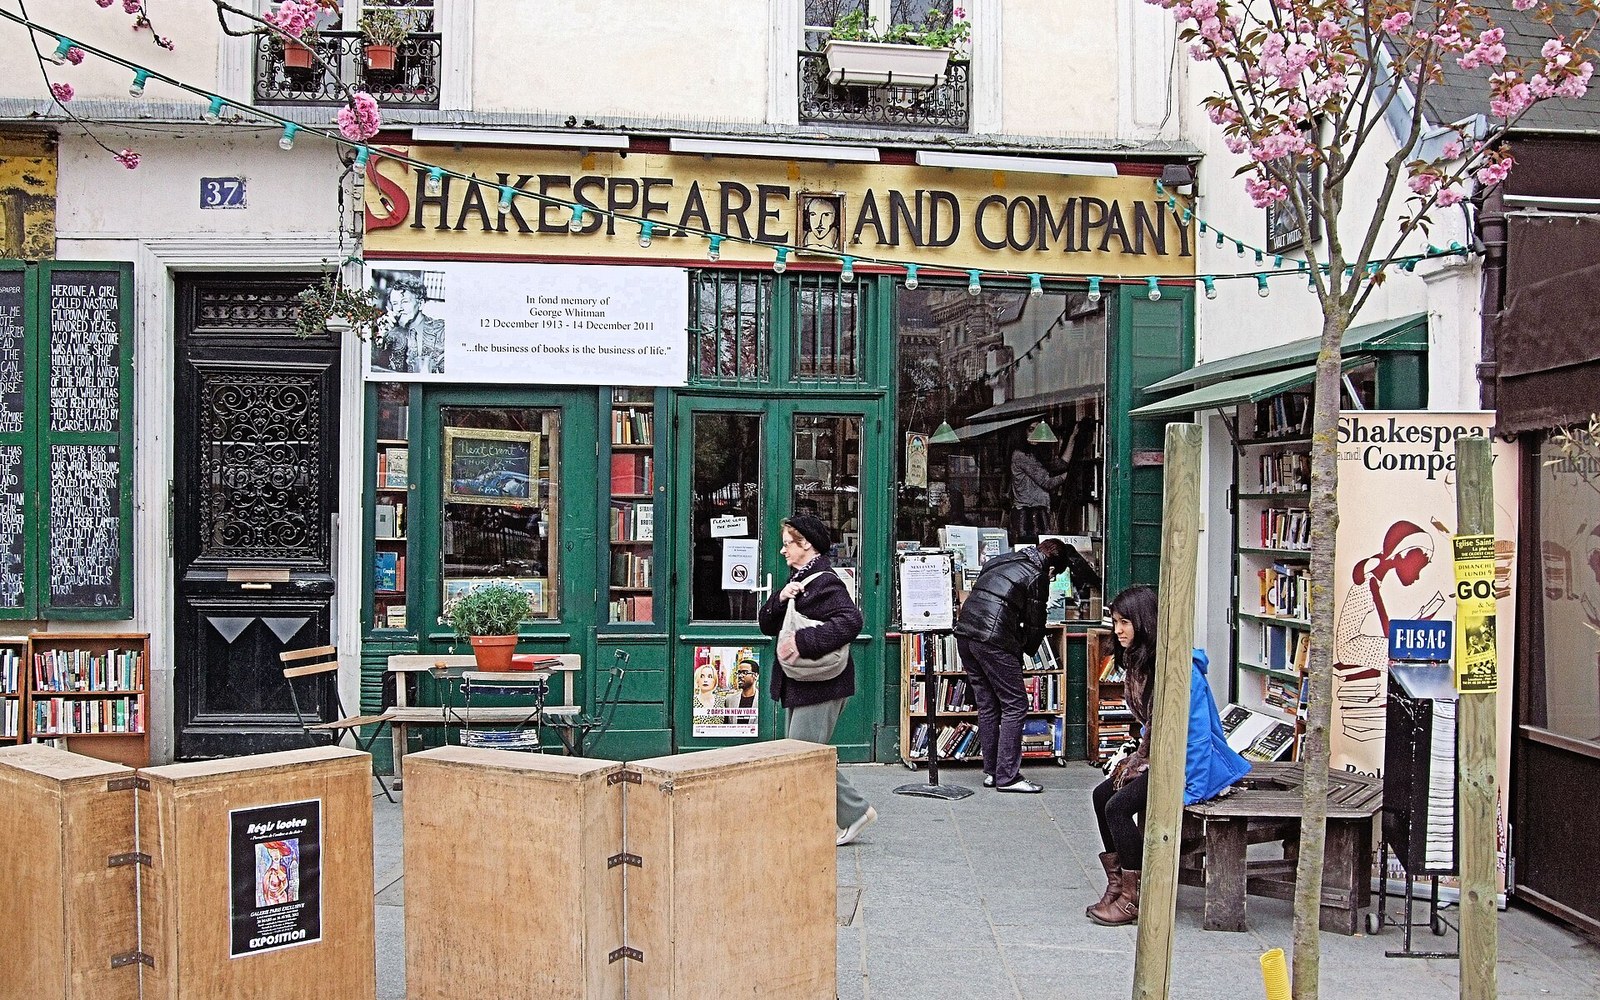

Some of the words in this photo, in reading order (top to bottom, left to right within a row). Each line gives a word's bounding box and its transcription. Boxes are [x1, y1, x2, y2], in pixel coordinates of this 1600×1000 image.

[207, 181, 239, 205] 37
[365, 147, 790, 244] SHAKESPEARE
[852, 188, 961, 247] AND
[974, 194, 1197, 257] COMPANY
[89, 285, 95, 297] A
[98, 285, 117, 298] GIRL
[52, 297, 80, 309] CALLED
[83, 297, 118, 310] NASTASIA
[526, 295, 535, 304] In
[538, 295, 559, 304] fond
[560, 297, 597, 307] memory
[599, 297, 610, 305] of
[93, 309, 111, 321] ONE
[529, 307, 562, 319] George
[565, 308, 606, 318] Whitman
[51, 320, 88, 332] HUNDRED
[91, 320, 116, 332] YEARS
[480, 318, 490, 328] 12
[493, 318, 539, 329] December
[542, 320, 563, 329] 1913
[573, 320, 583, 329] 14
[586, 320, 631, 330] December
[633, 321, 654, 331] 2011
[70, 332, 82, 344] MY
[83, 332, 119, 345] BOOKSTORE
[3, 349, 20, 360] THE
[51, 343, 66, 355] WAS
[66, 344, 73, 355] A
[92, 344, 114, 357] SHOP
[490, 343, 529, 353] business
[531, 344, 542, 353] of
[543, 344, 570, 354] books
[572, 344, 580, 354] is
[582, 345, 596, 354] the
[598, 345, 636, 355] business
[637, 346, 649, 355] of
[97, 355, 111, 367] THE
[74, 366, 83, 378] BY
[84, 366, 95, 377] AN
[103, 388, 119, 398] HAS
[76, 408, 110, 420] REPLACED
[110, 409, 119, 420] BY
[50, 420, 58, 431] A
[93, 420, 113, 432] AND
[52, 445, 86, 454] FURTHER
[87, 445, 107, 454] BACK
[108, 445, 117, 454] IN
[52, 453, 66, 462] THE
[68, 453, 88, 463] YEAR
[90, 453, 106, 462] 1600
[51, 462, 66, 471] OUR
[74, 470, 115, 480] MONASTERY
[51, 479, 78, 488] CALLED
